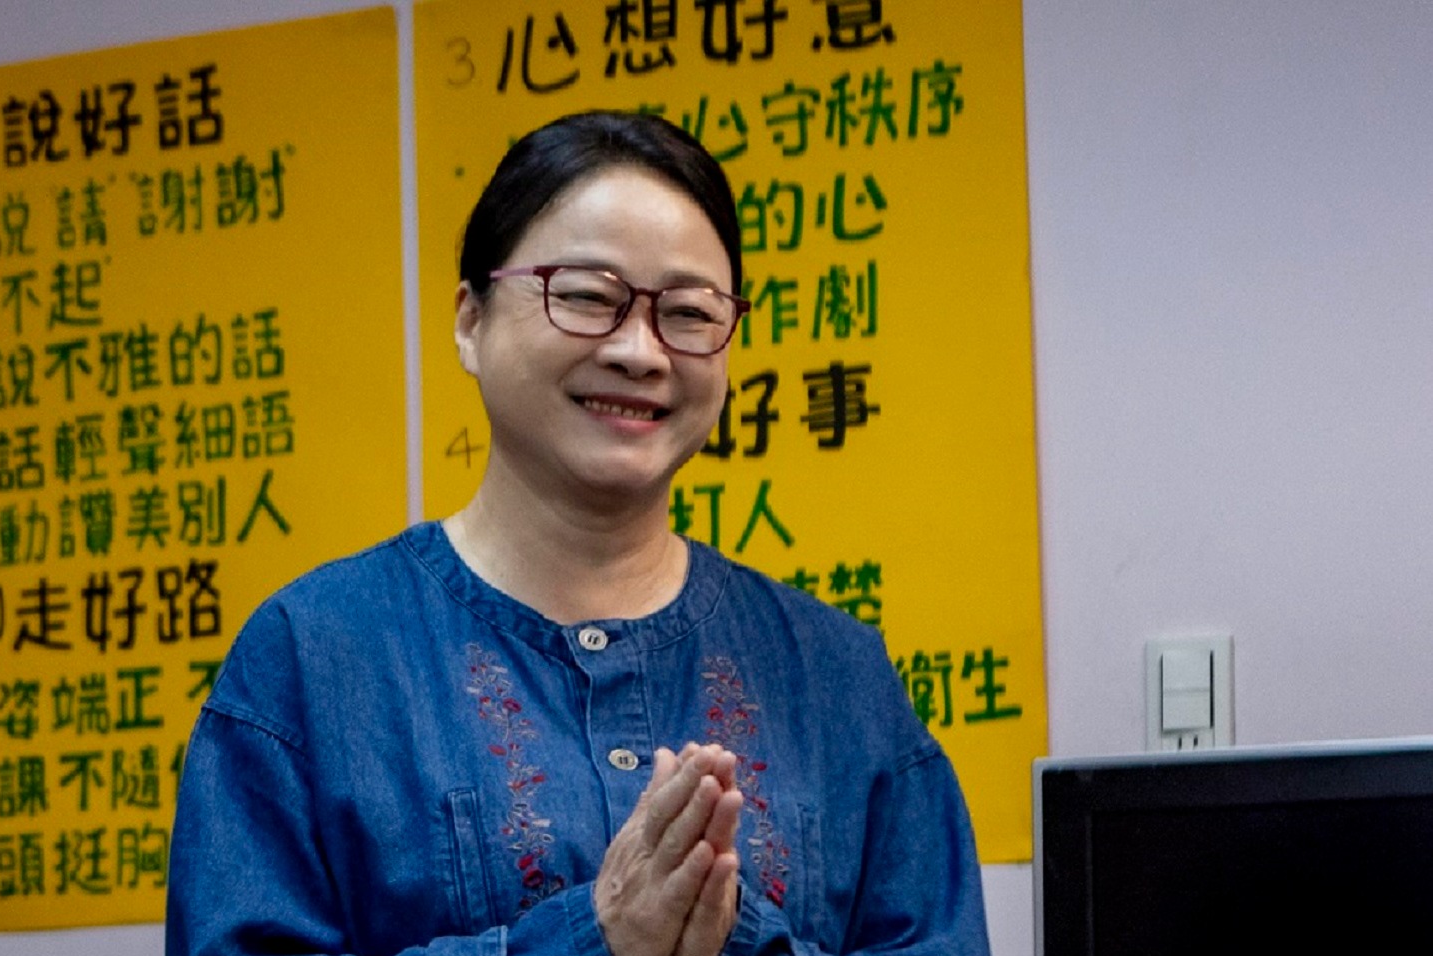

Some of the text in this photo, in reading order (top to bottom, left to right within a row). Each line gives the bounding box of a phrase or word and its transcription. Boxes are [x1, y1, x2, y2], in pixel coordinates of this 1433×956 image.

[445, 0, 897, 93] 3 心想好意
[639, 60, 964, 162] 心守秩序
[446, 426, 485, 469] 4
